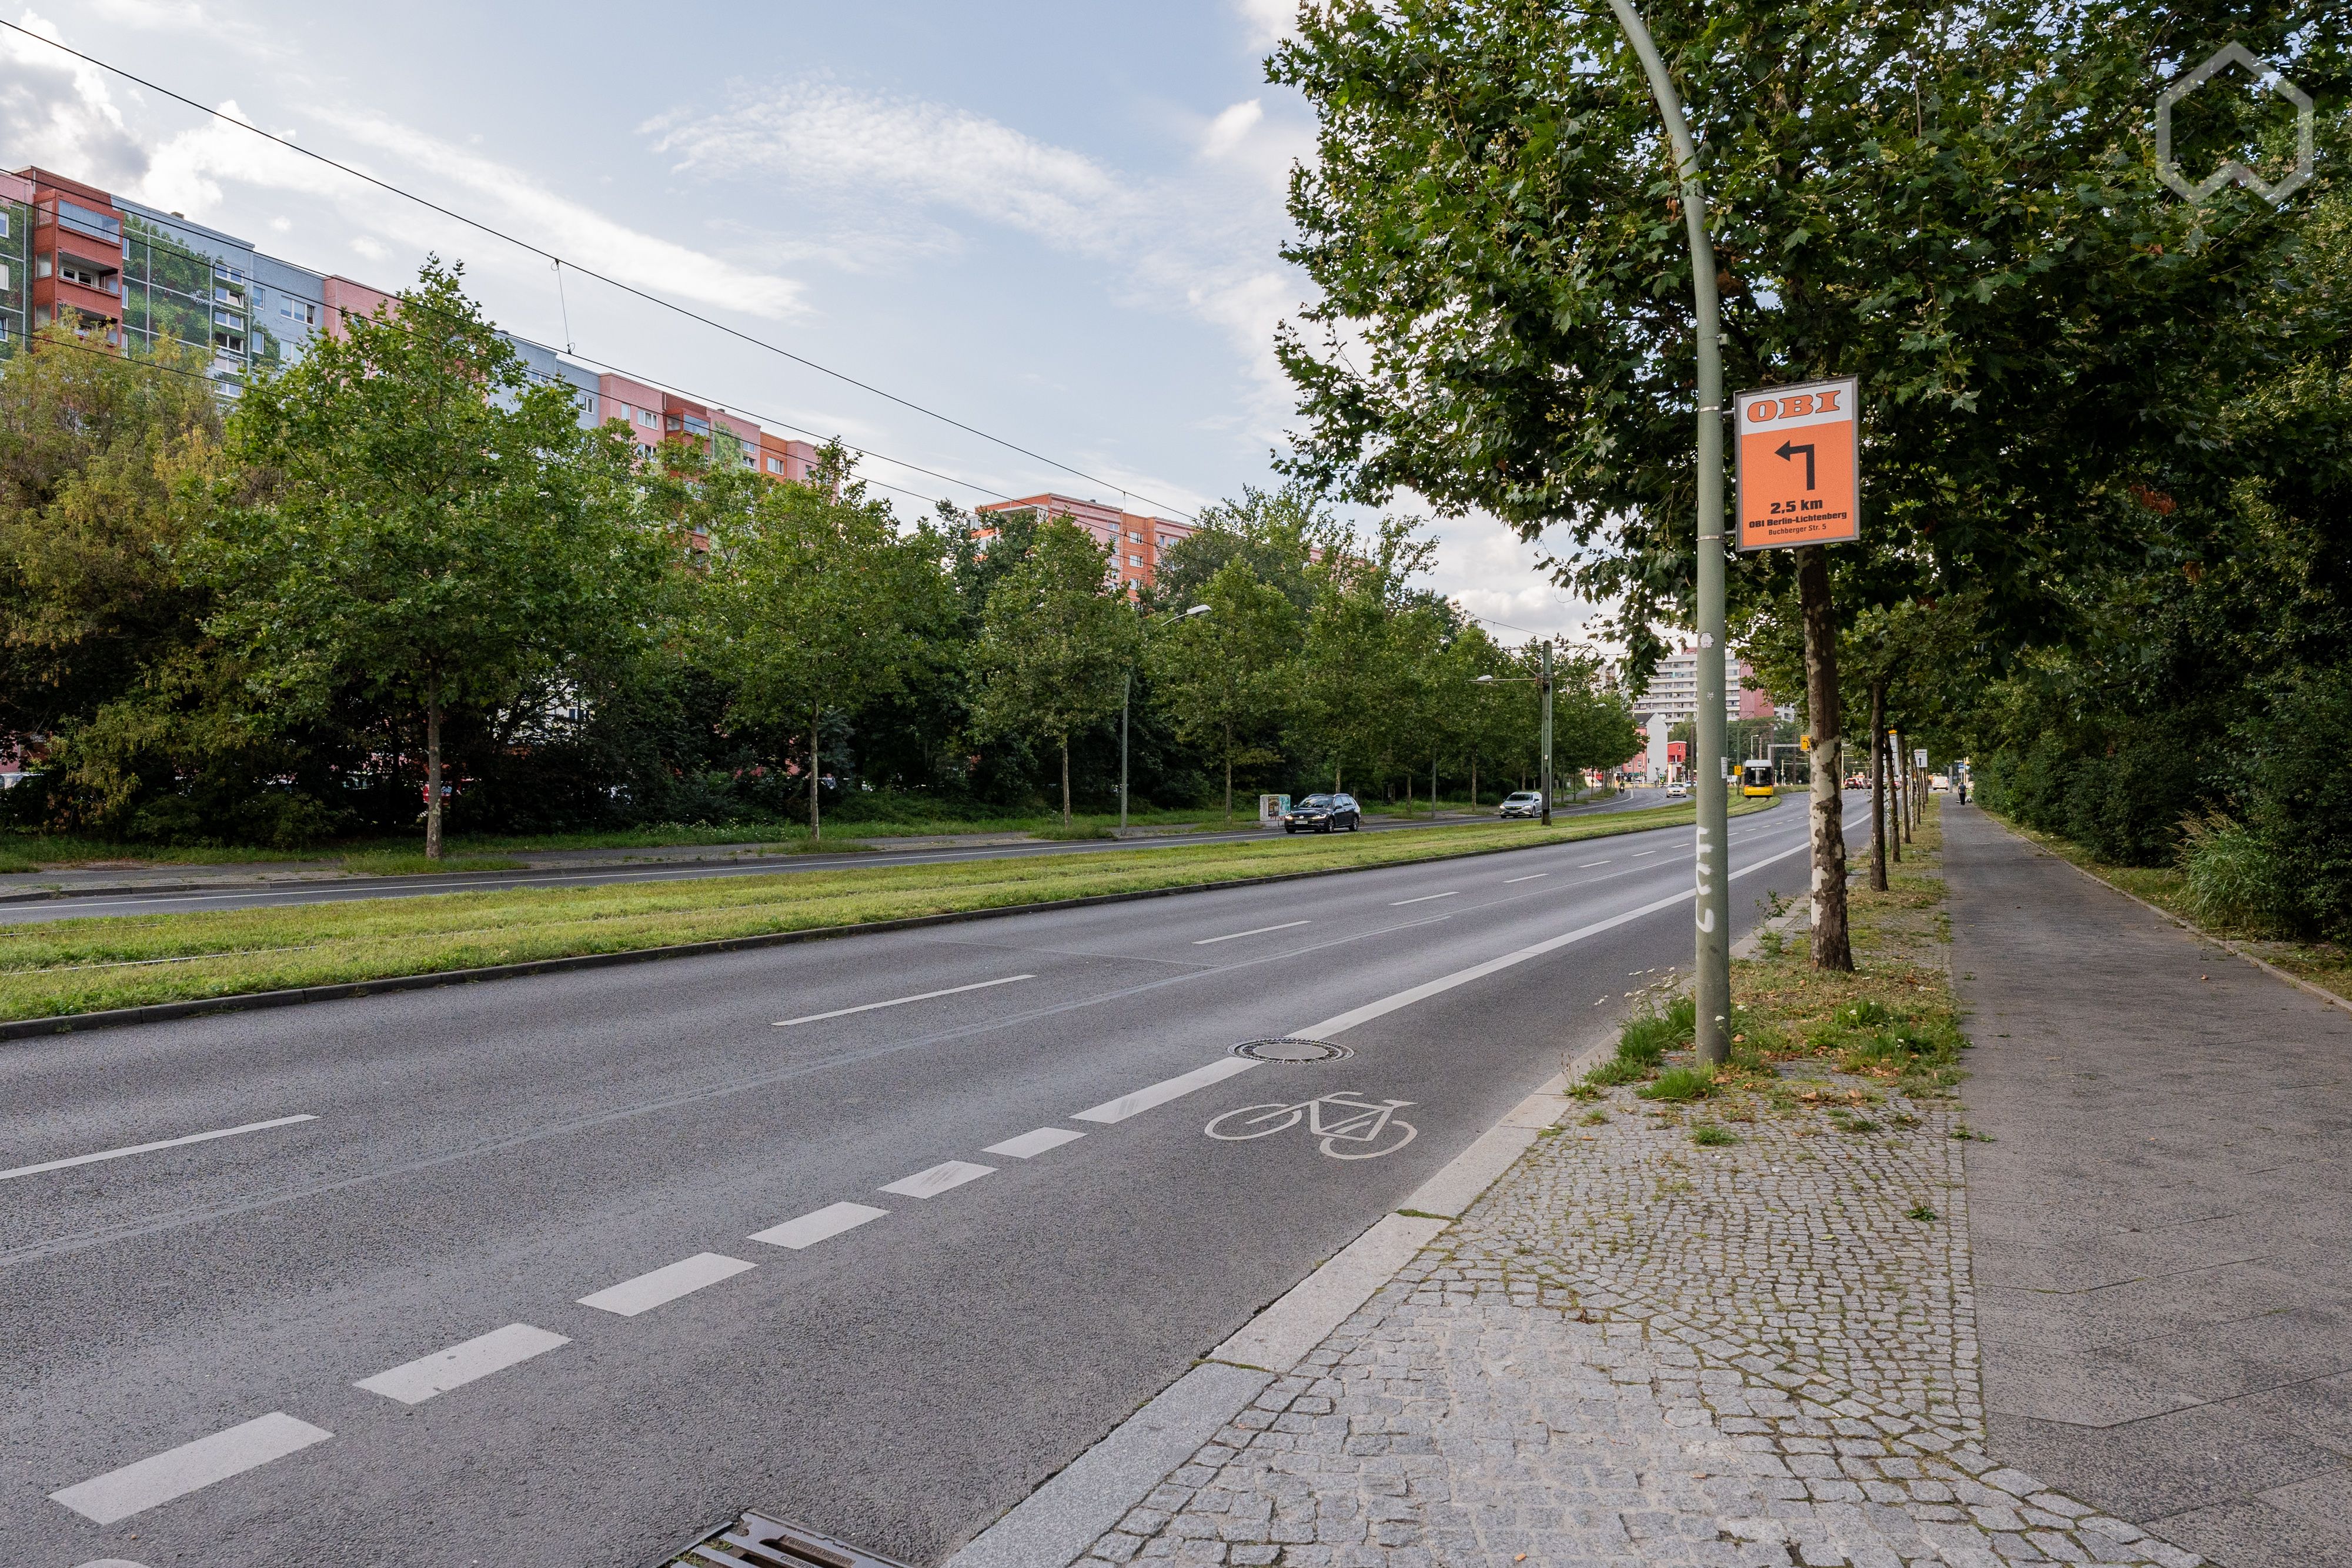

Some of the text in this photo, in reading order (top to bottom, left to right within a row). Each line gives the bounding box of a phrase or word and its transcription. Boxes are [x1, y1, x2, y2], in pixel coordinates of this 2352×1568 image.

[1747, 390, 1841, 423] OBI
[1770, 499, 1823, 514] 2,5 km
[1767, 512, 1847, 526] Berlin-Lichtenberg
[1769, 527, 1807, 535] Buchberger
